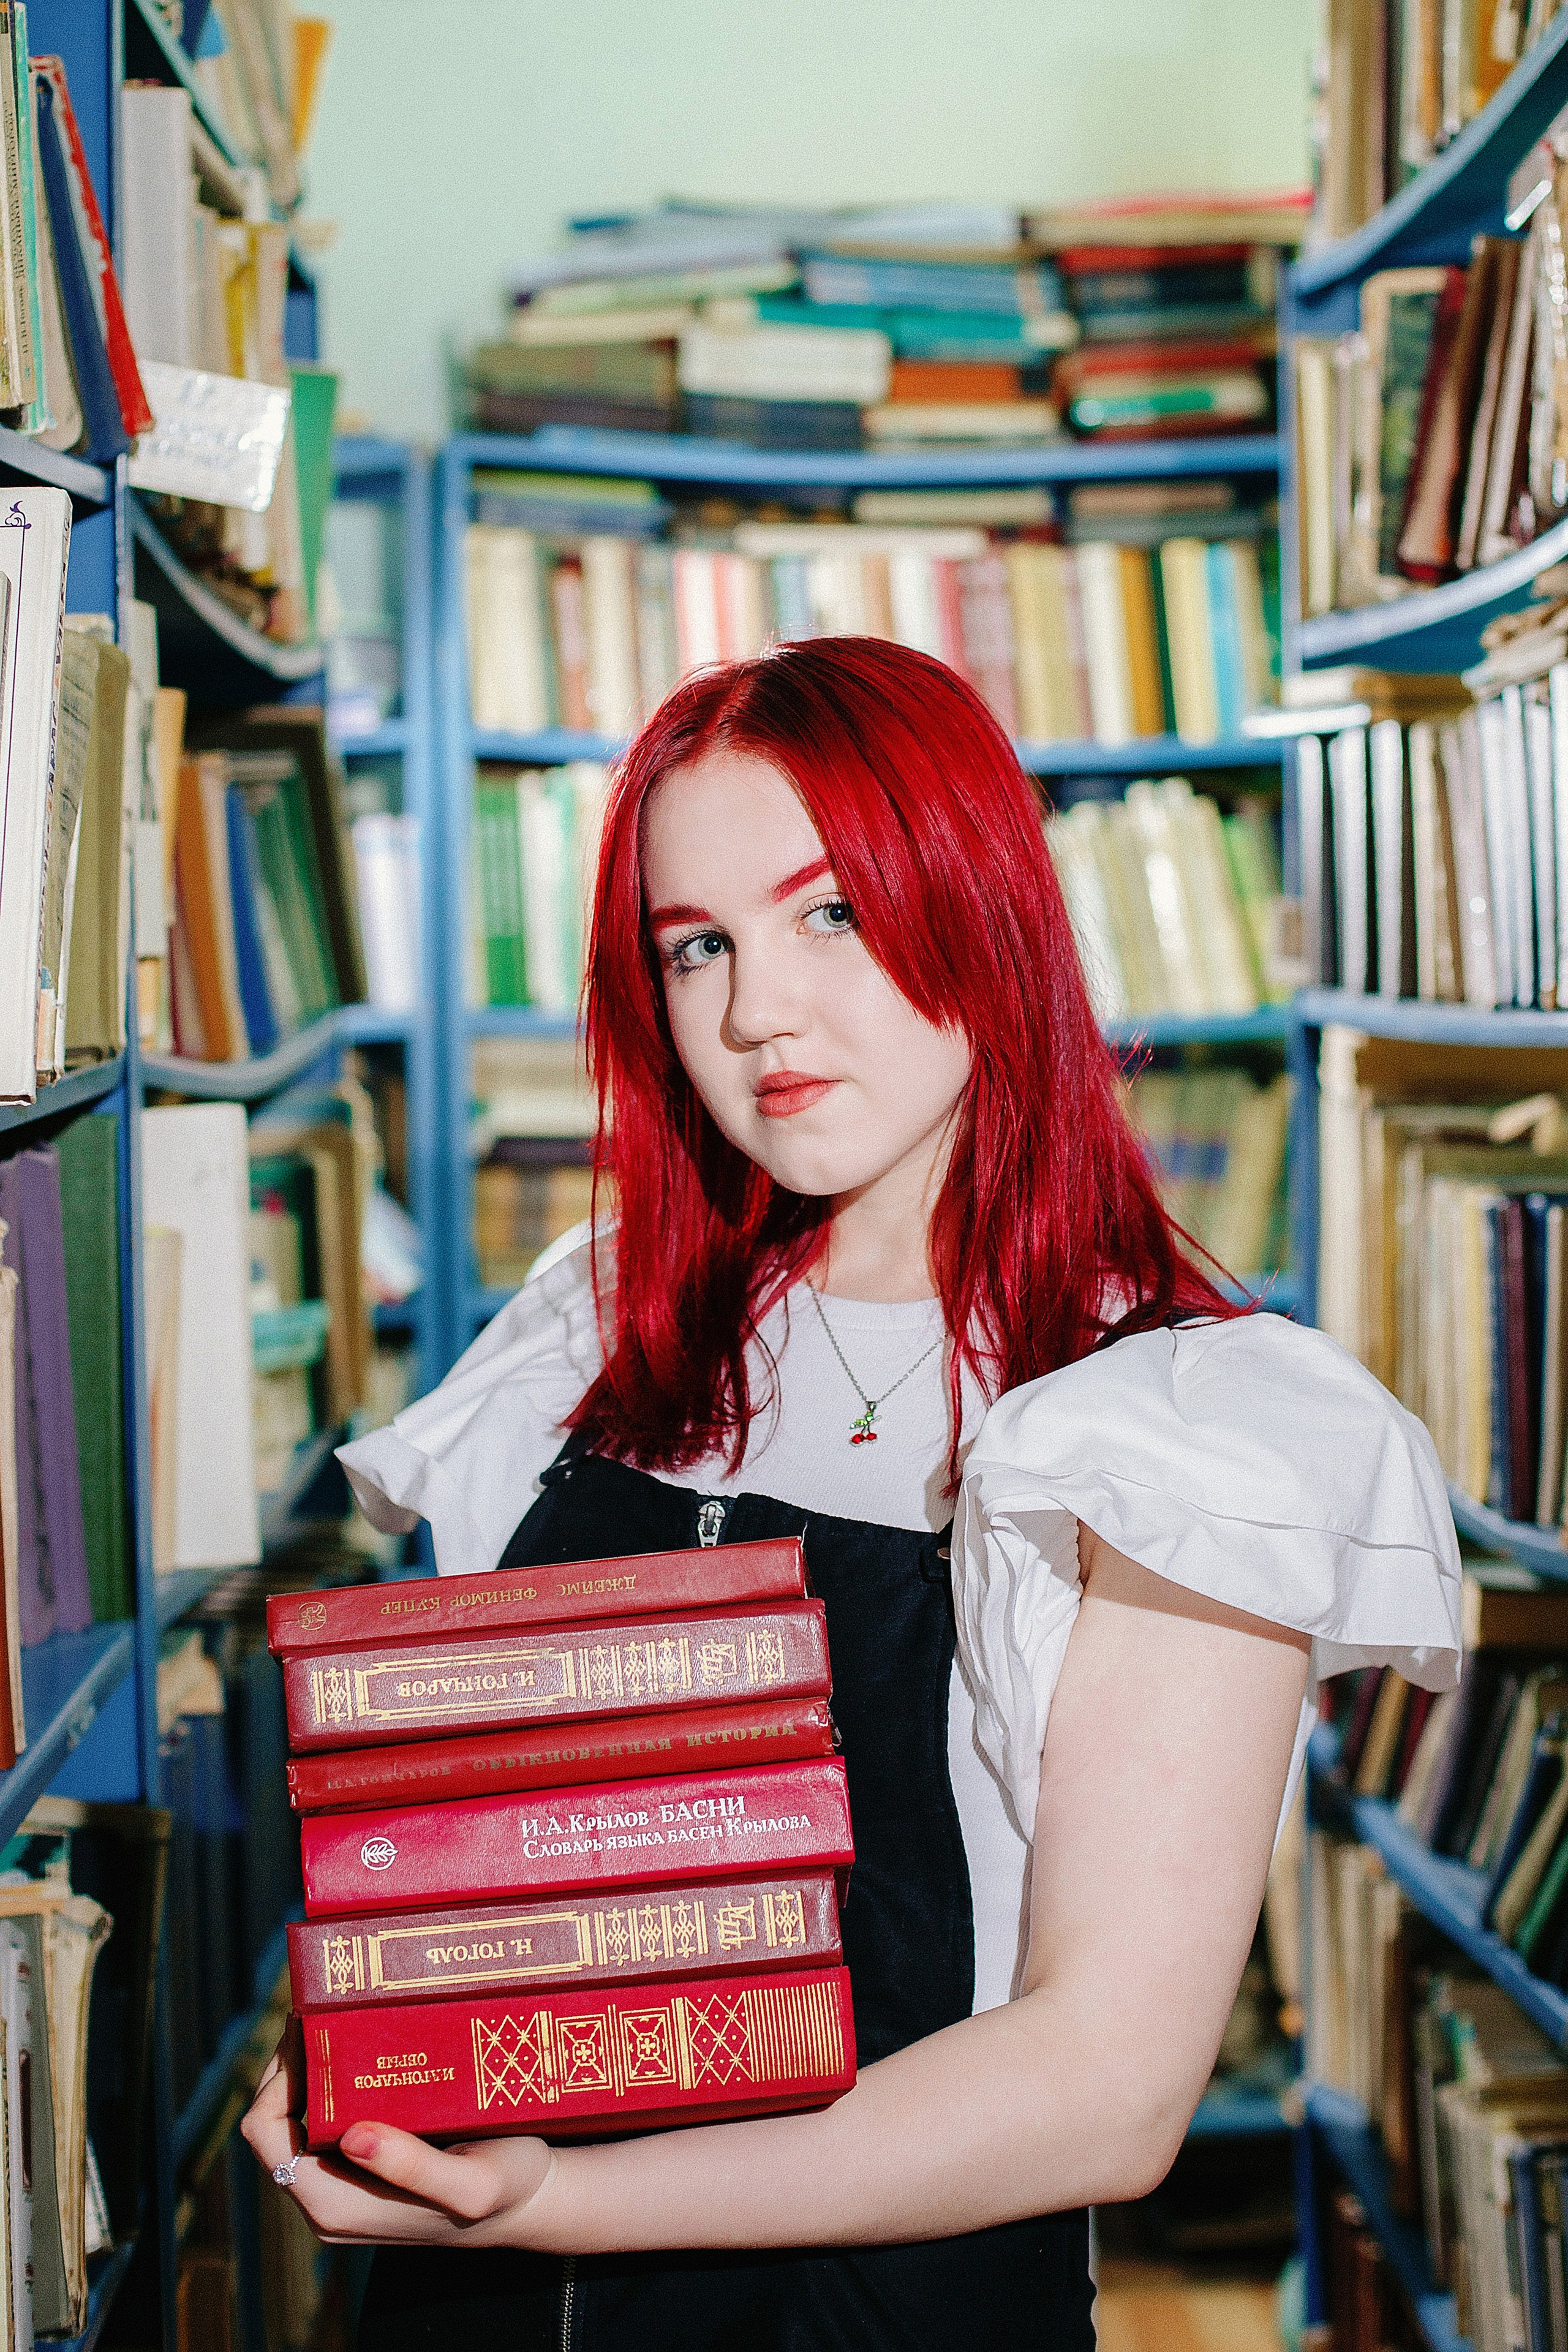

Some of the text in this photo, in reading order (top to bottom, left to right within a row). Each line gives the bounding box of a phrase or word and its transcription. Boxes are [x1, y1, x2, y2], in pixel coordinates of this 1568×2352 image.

[380, 1574, 636, 1615] ДЖЕЙМС ФЕНИМОР КУПЕР
[398, 1675, 509, 1698] ГОНЧАРОВ
[473, 1738, 672, 1770] ОБЫКНОВЕННАЯ
[687, 1722, 797, 1747] ИСТОРИЯ
[659, 1795, 745, 1824] БАСНИ
[426, 1938, 532, 1965] Н. ГОГОЛЬ
[376, 2052, 428, 2070] ОБРЫВ
